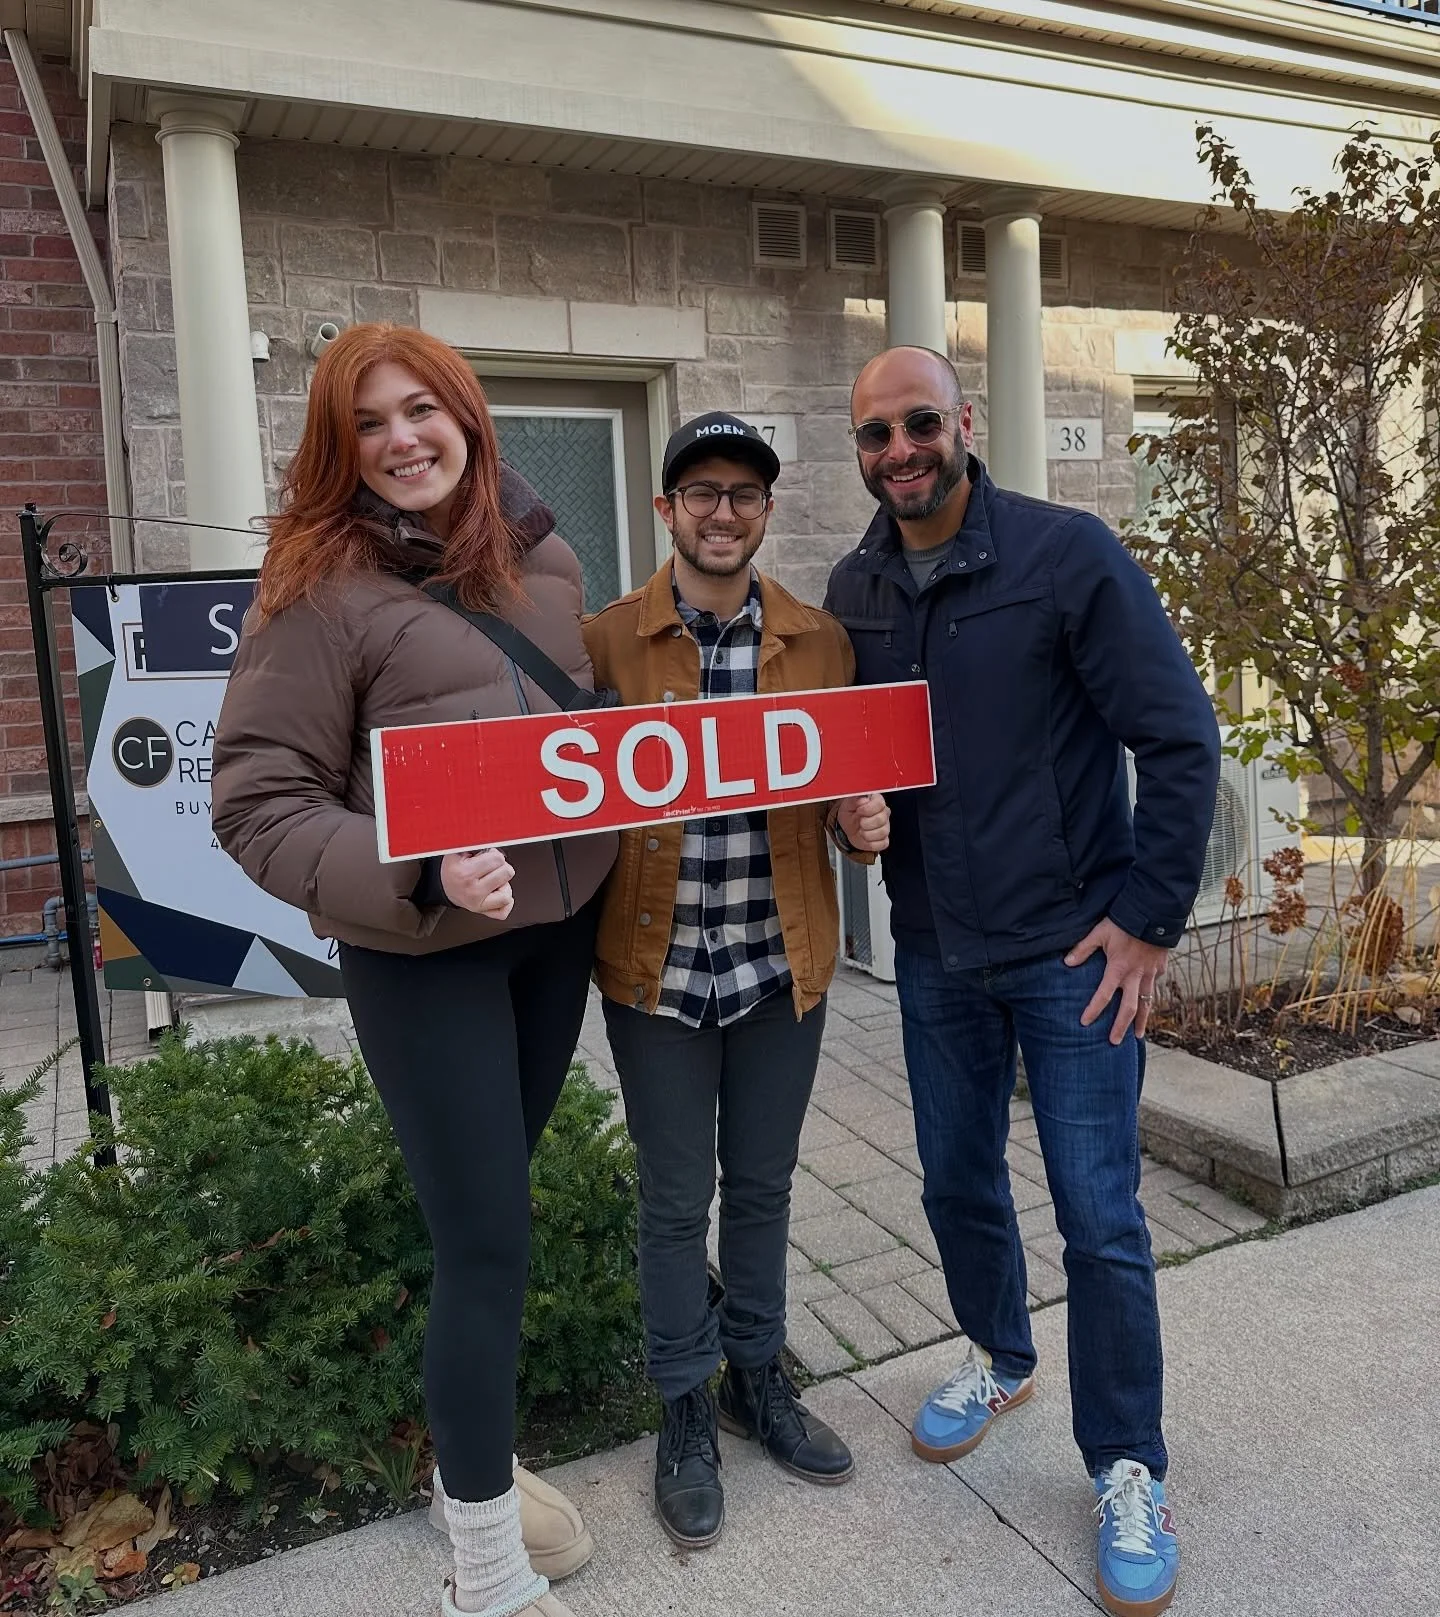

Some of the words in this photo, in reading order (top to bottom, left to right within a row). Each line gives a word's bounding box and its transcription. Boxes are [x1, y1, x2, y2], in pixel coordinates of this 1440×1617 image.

[695, 424, 745, 438] MOEN
[1060, 426, 1086, 452] 38
[118, 736, 168, 770] CF
[540, 708, 824, 820] SOLD
